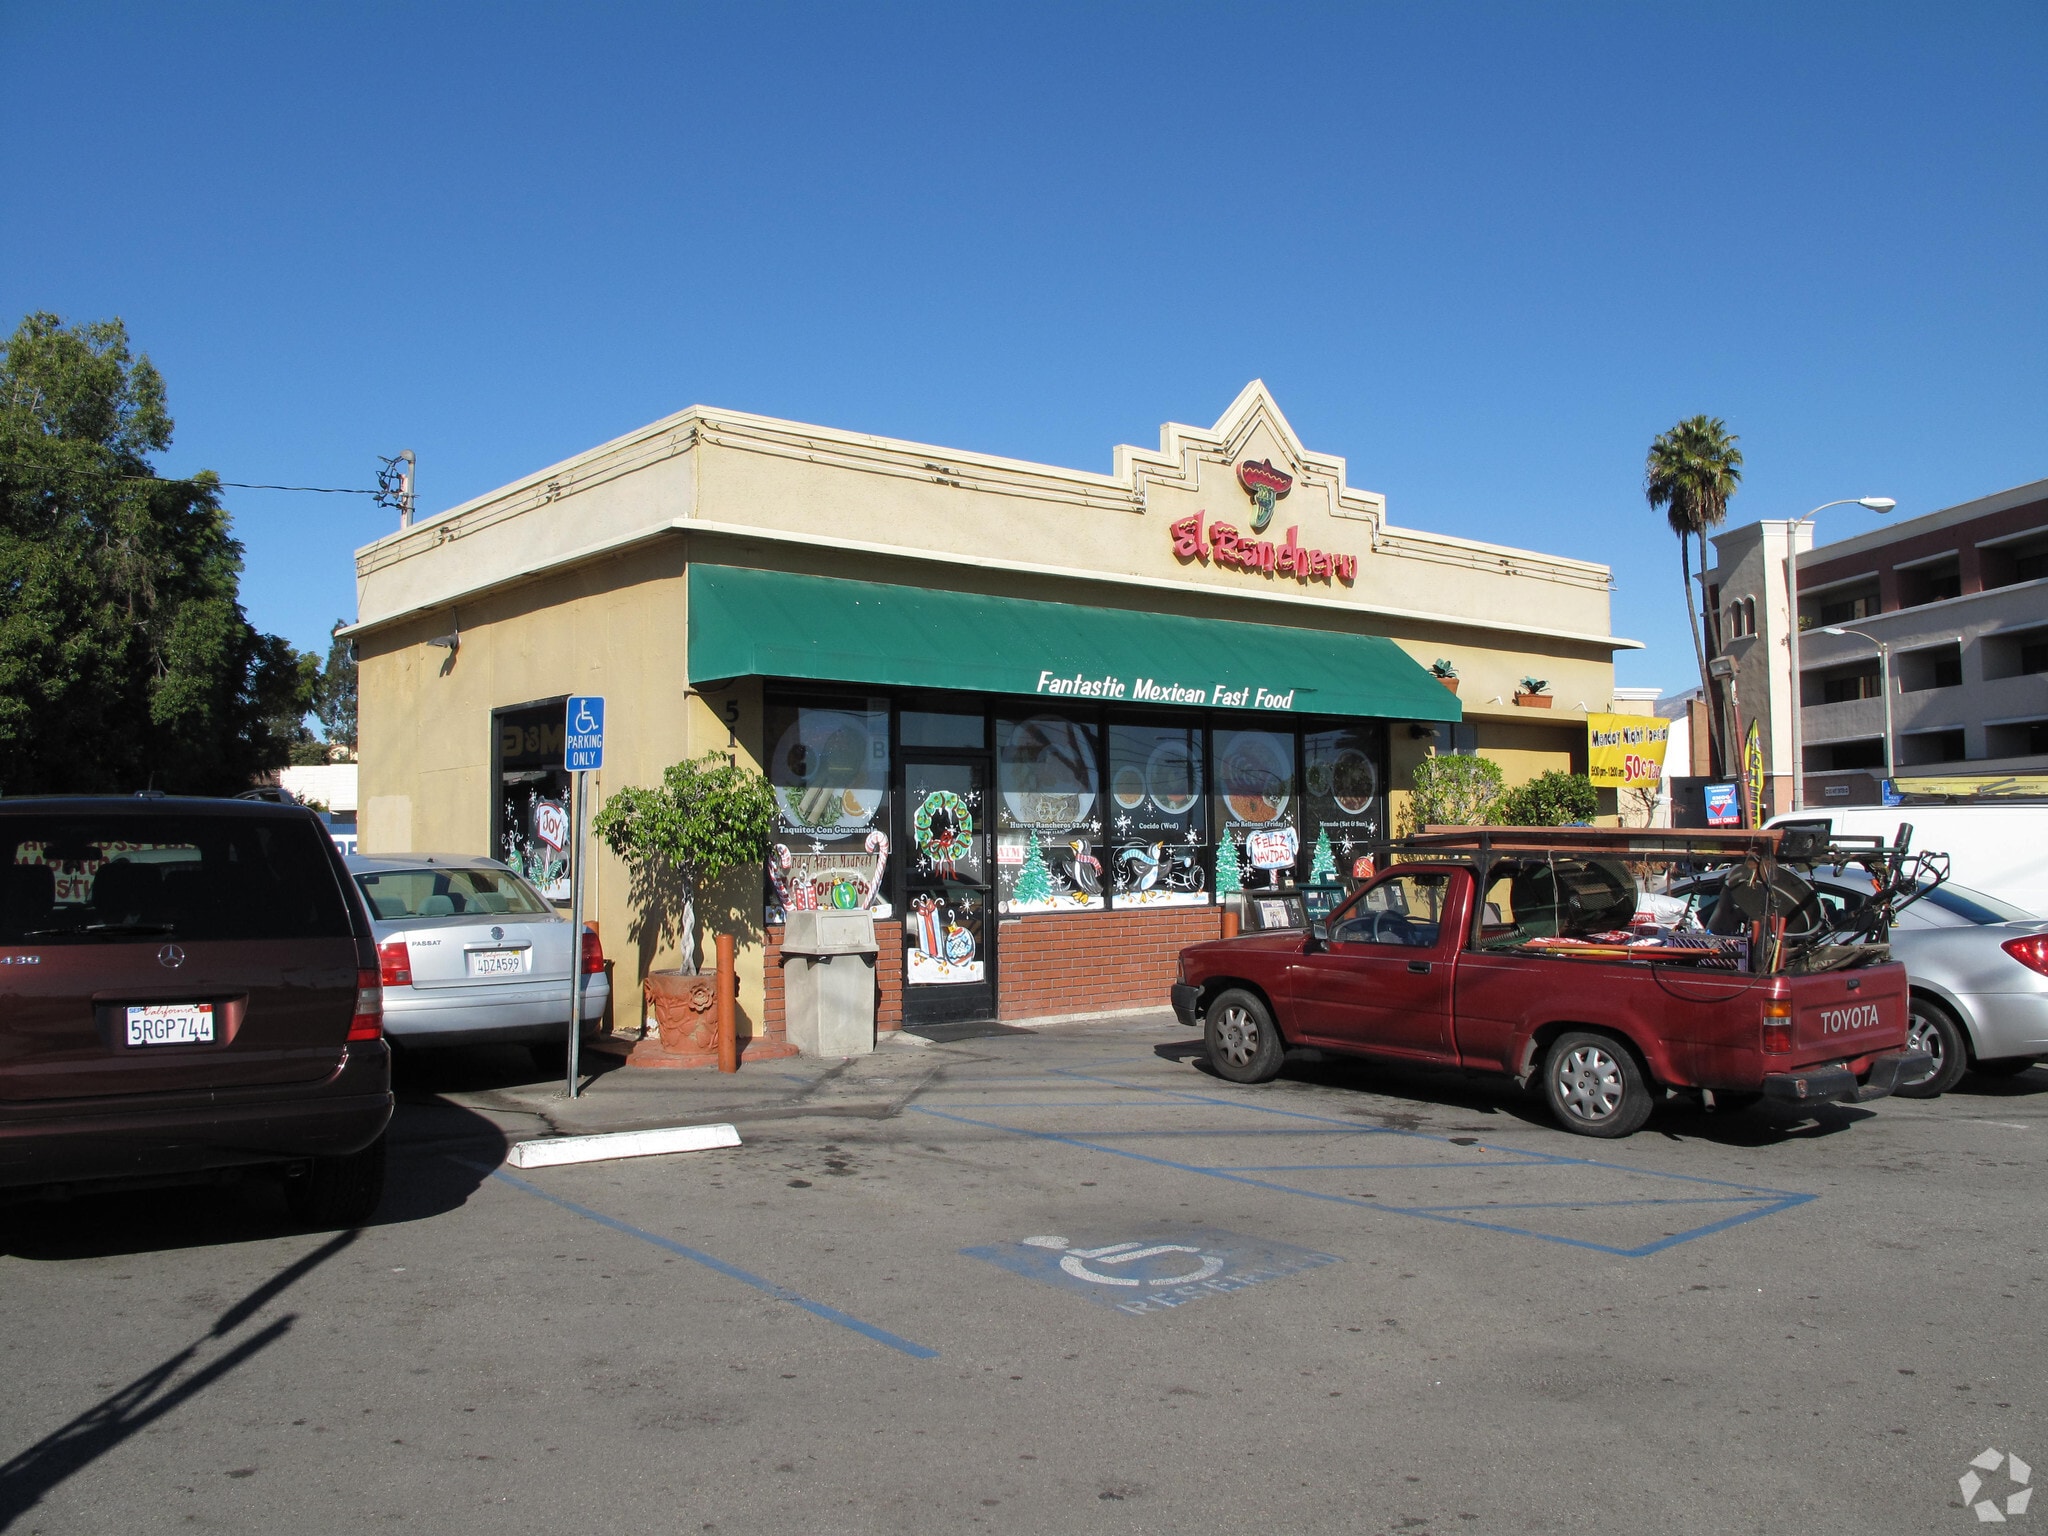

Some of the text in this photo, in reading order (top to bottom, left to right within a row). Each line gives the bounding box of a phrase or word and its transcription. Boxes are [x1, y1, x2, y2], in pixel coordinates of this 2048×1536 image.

[1170, 509, 1209, 559] El
[1037, 670, 1294, 710] Fantastic Mexican Fast Food
[568, 734, 602, 750] PARKING
[872, 741, 887, 759] B
[573, 751, 596, 766] ONLY
[779, 825, 815, 835] Taquitos
[816, 826, 833, 834] Con
[1009, 821, 1035, 829] Huevos
[1035, 821, 1071, 829] Rancheros
[1138, 822, 1179, 830] Cocido (Wed)
[1225, 820, 1242, 828] Chile
[1264, 820, 1287, 829] (Friday)
[1254, 834, 1287, 848] FELIZ
[998, 847, 1020, 857] ATM
[1253, 849, 1291, 864] NAVIDAD
[477, 957, 520, 974] 4DZA599
[143, 1006, 194, 1018] California
[1820, 1004, 1879, 1034] TOYOTA
[131, 1017, 210, 1041] 5RGP744
